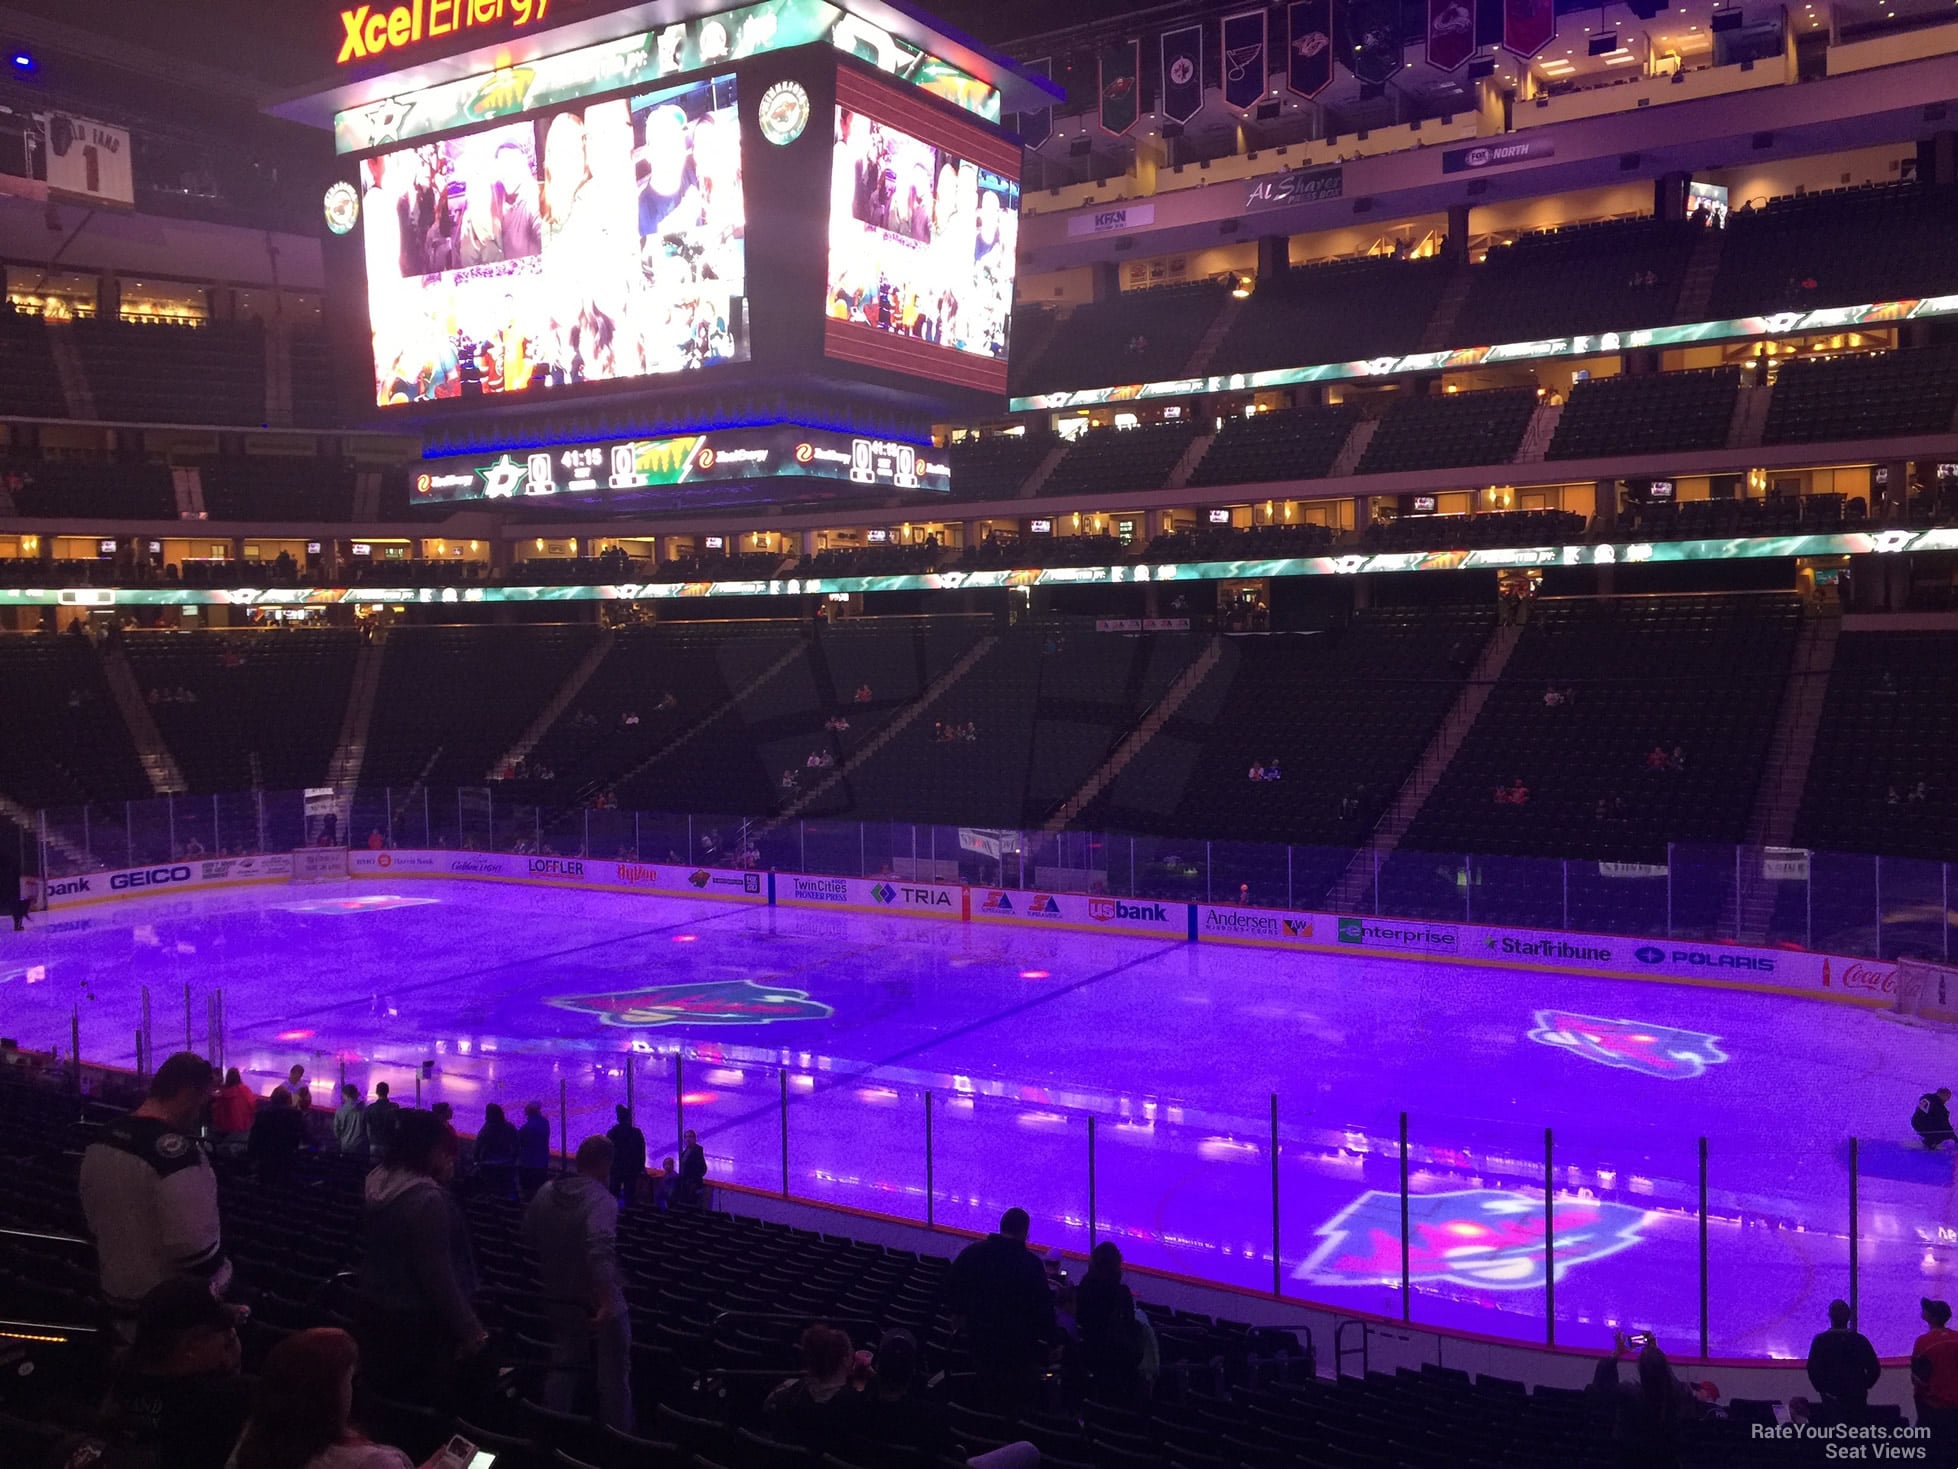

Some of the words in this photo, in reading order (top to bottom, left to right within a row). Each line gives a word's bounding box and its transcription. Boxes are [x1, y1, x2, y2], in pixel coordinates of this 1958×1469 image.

[1493, 144, 1530, 160] NORTH
[83, 144, 99, 193] 1
[1095, 210, 1127, 227] KFAN
[561, 449, 602, 468] 41:15
[528, 859, 584, 876] LOFFLER
[110, 866, 192, 890] GEICO
[795, 889, 825, 900] PIONEER
[826, 892, 848, 902] PRESS
[901, 887, 952, 906] TRIA
[1206, 909, 1279, 930] Andersen
[1344, 924, 1457, 945] enterprise
[1502, 937, 1612, 962] StarTribune
[1672, 951, 1777, 972] POLARIS
